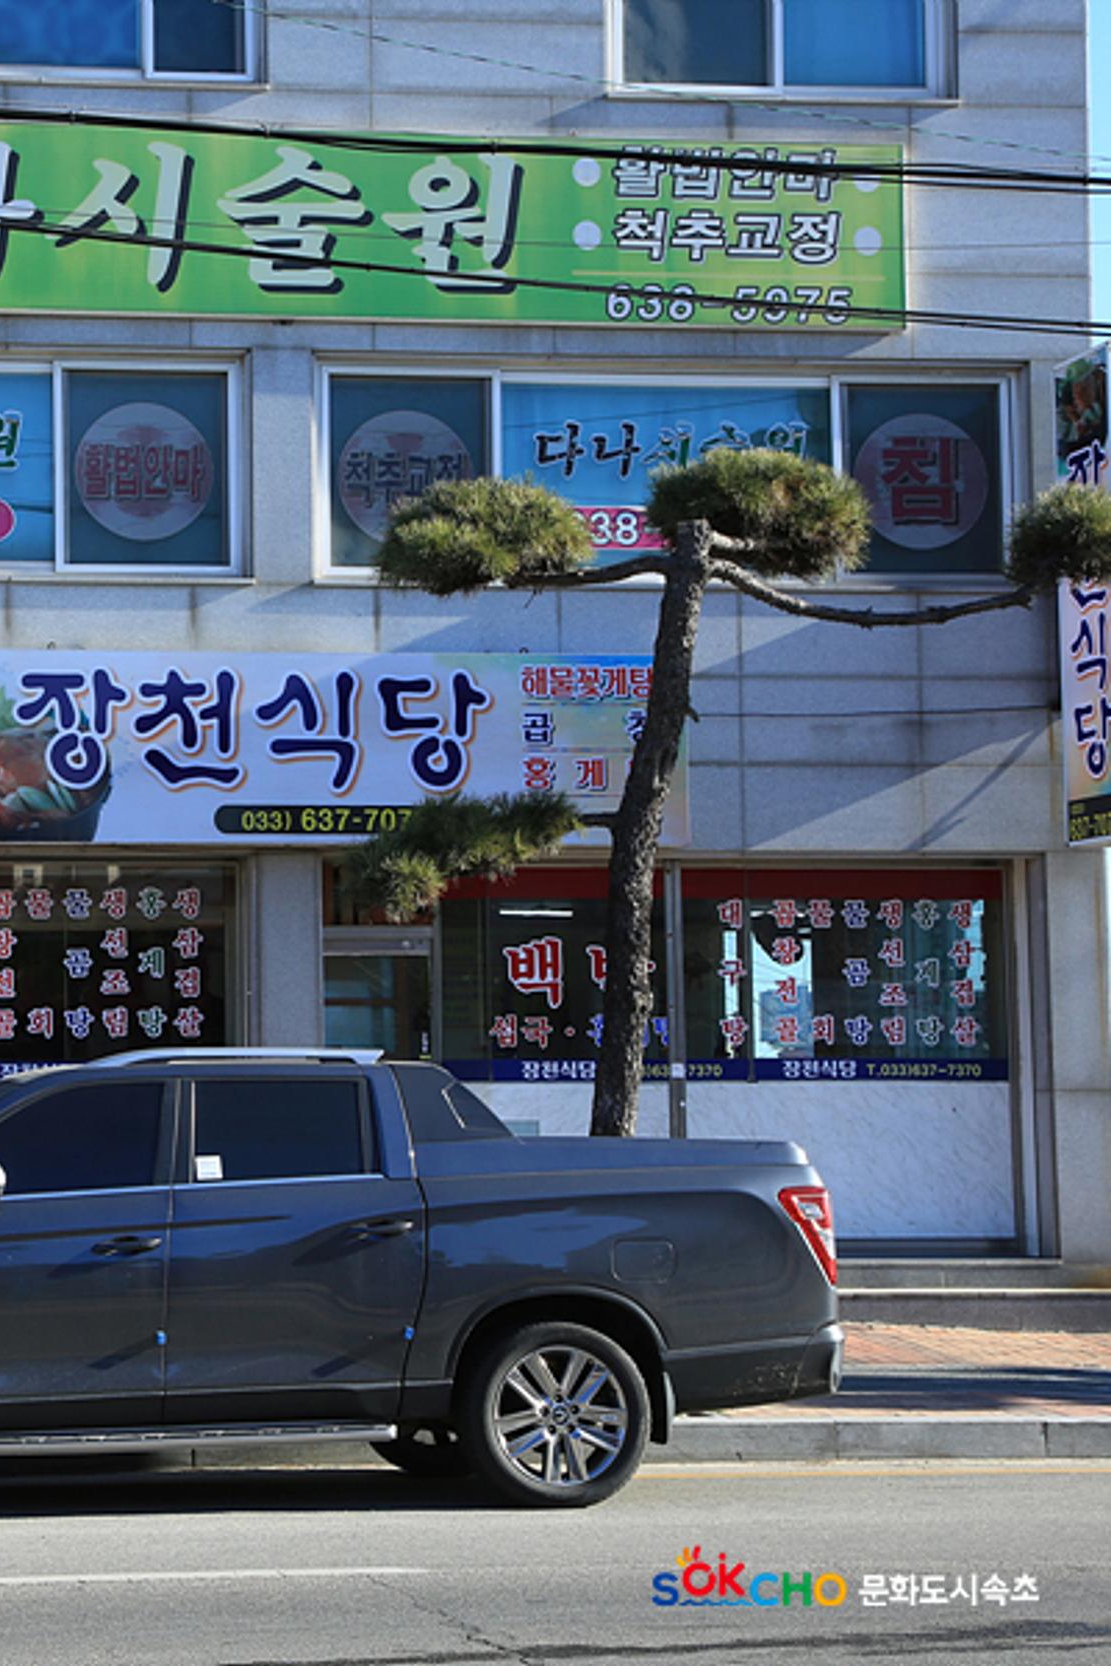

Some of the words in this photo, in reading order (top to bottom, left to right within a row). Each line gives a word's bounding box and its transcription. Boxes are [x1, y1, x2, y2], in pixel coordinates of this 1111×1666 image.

[611, 144, 840, 201] 활법안마
[611, 207, 844, 265] 척추교정
[605, 283, 853, 325] 638-5975
[82, 442, 212, 503] 활법안마
[879, 436, 966, 527] 침
[521, 665, 654, 699] 해물꽃게탕
[15, 668, 489, 789] 장천식당
[240, 810, 293, 832] 033)
[781, 1060, 857, 1079] 장천식당
